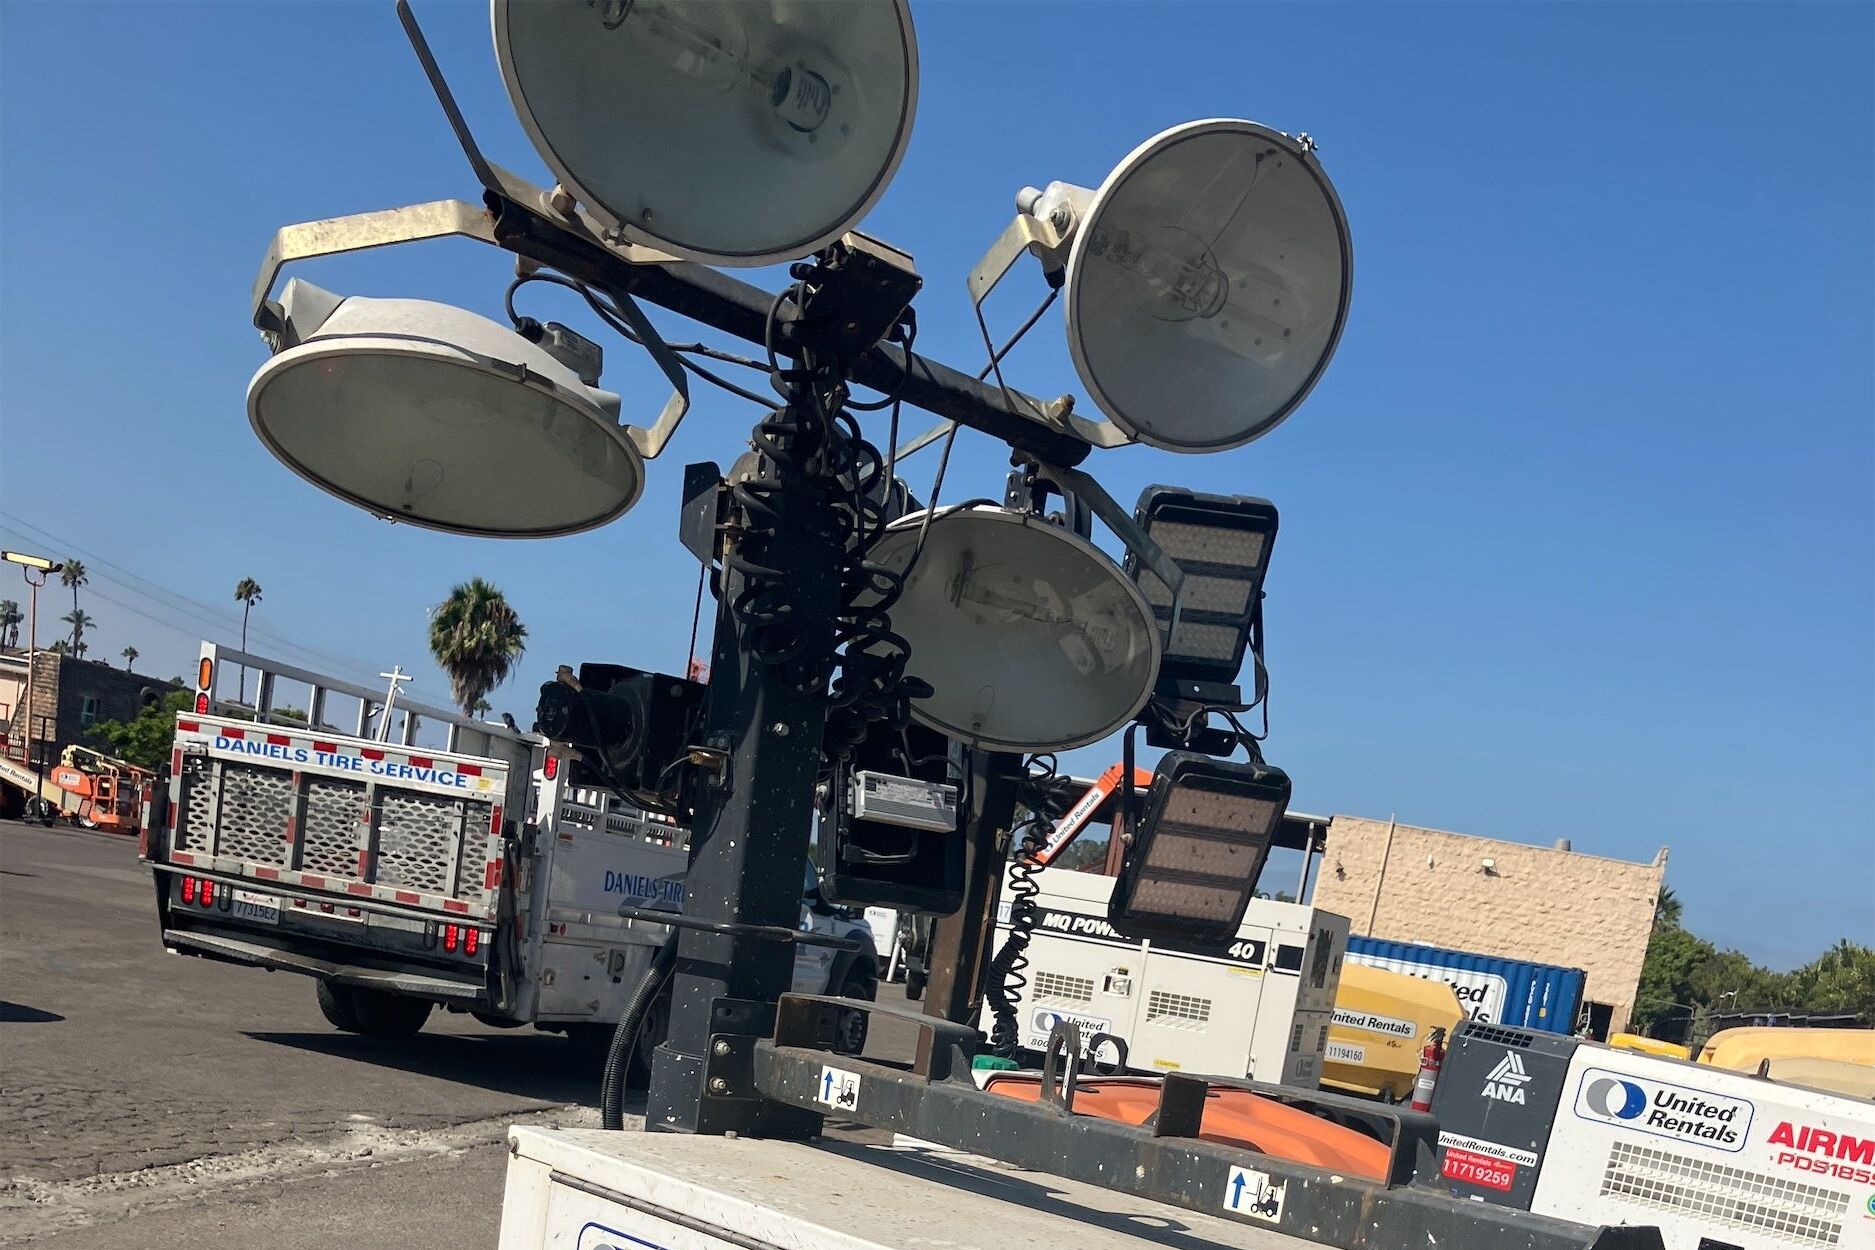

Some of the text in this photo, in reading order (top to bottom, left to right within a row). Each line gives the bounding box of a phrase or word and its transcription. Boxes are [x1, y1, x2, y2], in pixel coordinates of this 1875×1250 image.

[216, 736, 308, 763] DANIELS
[316, 752, 363, 773] TIRE
[370, 761, 468, 788] SERVICE
[1052, 792, 1100, 843] United Rentals
[604, 870, 658, 899] DANIELS
[1042, 912, 1131, 940] MQ POW
[1228, 942, 1255, 959] 40
[1367, 1016, 1411, 1035] Rentals
[1328, 1046, 1363, 1061] 11194160
[1481, 1082, 1525, 1105] ANA
[1654, 1090, 1738, 1122] United
[1646, 1109, 1738, 1144] Rentals
[1767, 1121, 1875, 1166] AIRM
[1444, 1159, 1510, 1186] 11719259
